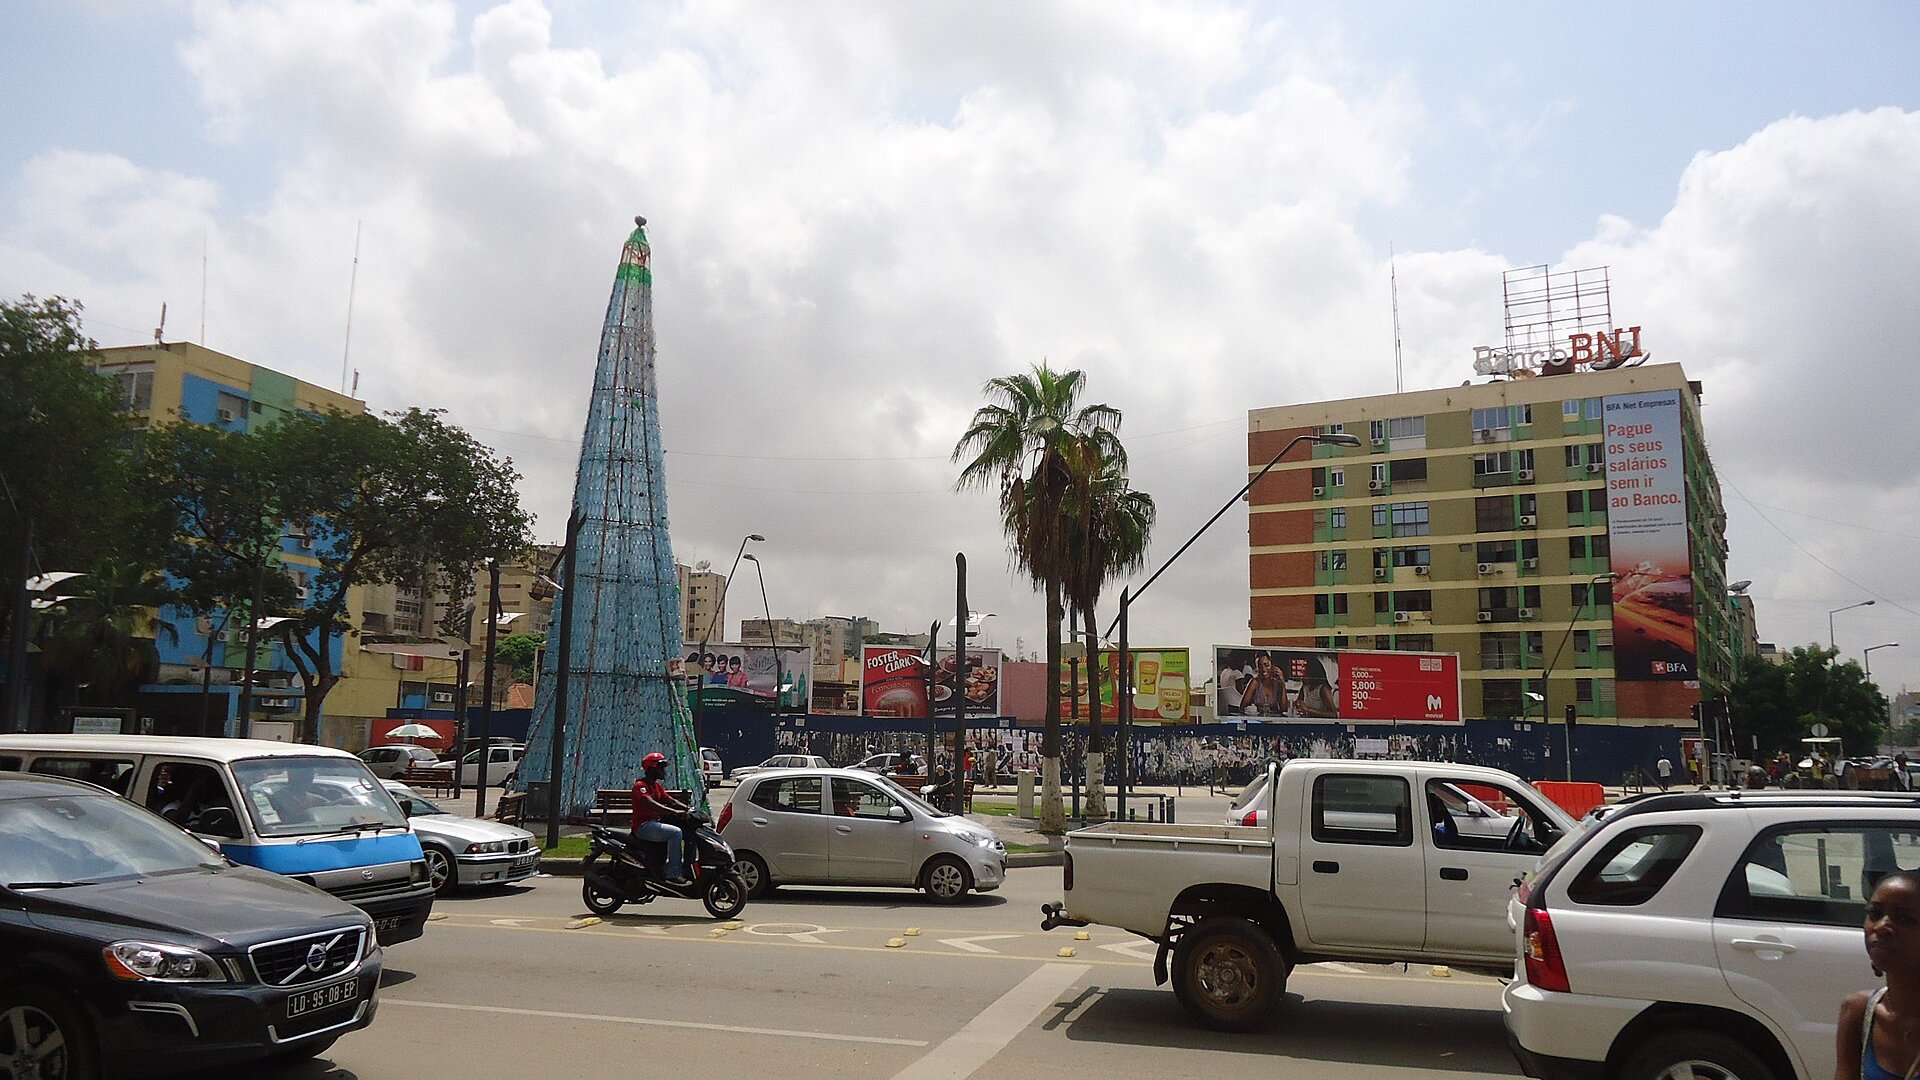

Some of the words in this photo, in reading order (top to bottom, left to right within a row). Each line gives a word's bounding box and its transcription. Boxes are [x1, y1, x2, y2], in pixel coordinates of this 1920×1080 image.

[1569, 326, 1643, 365] BNI
[1606, 403, 1621, 412] BFA
[1623, 402, 1637, 410] Net
[1639, 399, 1676, 409] Empresas
[1607, 423, 1653, 438] Pague
[1608, 443, 1625, 454] os
[1629, 440, 1663, 452] seus
[1609, 456, 1667, 472] salários
[1610, 478, 1640, 490] sem
[1644, 474, 1654, 488] ir
[1611, 497, 1629, 508] ao
[1633, 493, 1681, 507] Banco.
[867, 650, 899, 669] FOSTER
[1666, 662, 1687, 672] BFA
[1352, 671, 1369, 679] 5,000
[1352, 681, 1375, 691] 5,800
[1352, 691, 1369, 700] 500
[1352, 701, 1363, 710] 50
